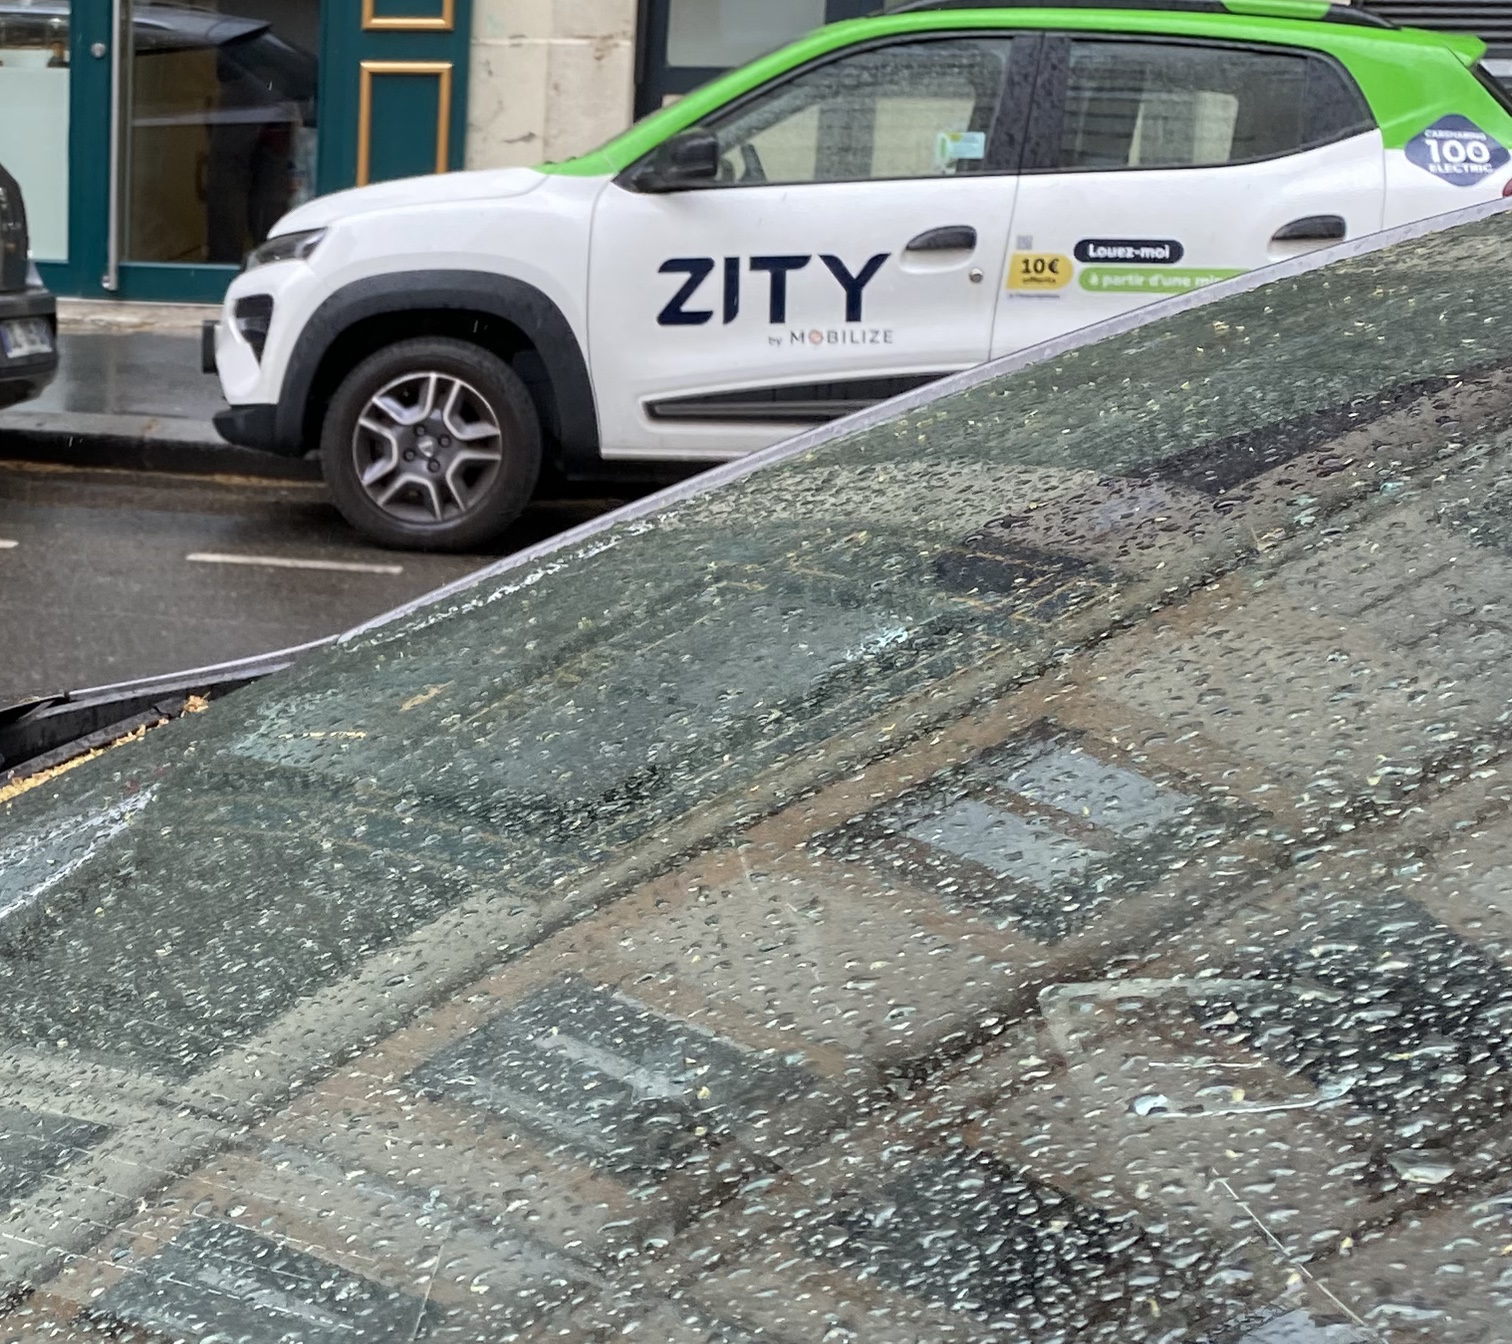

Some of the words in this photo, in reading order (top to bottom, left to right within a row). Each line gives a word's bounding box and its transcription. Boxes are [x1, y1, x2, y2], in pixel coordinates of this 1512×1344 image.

[1424, 138, 1490, 163] 100
[656, 252, 892, 326] ZITY
[768, 335, 783, 347] by
[789, 329, 894, 346] MOBILIZE
